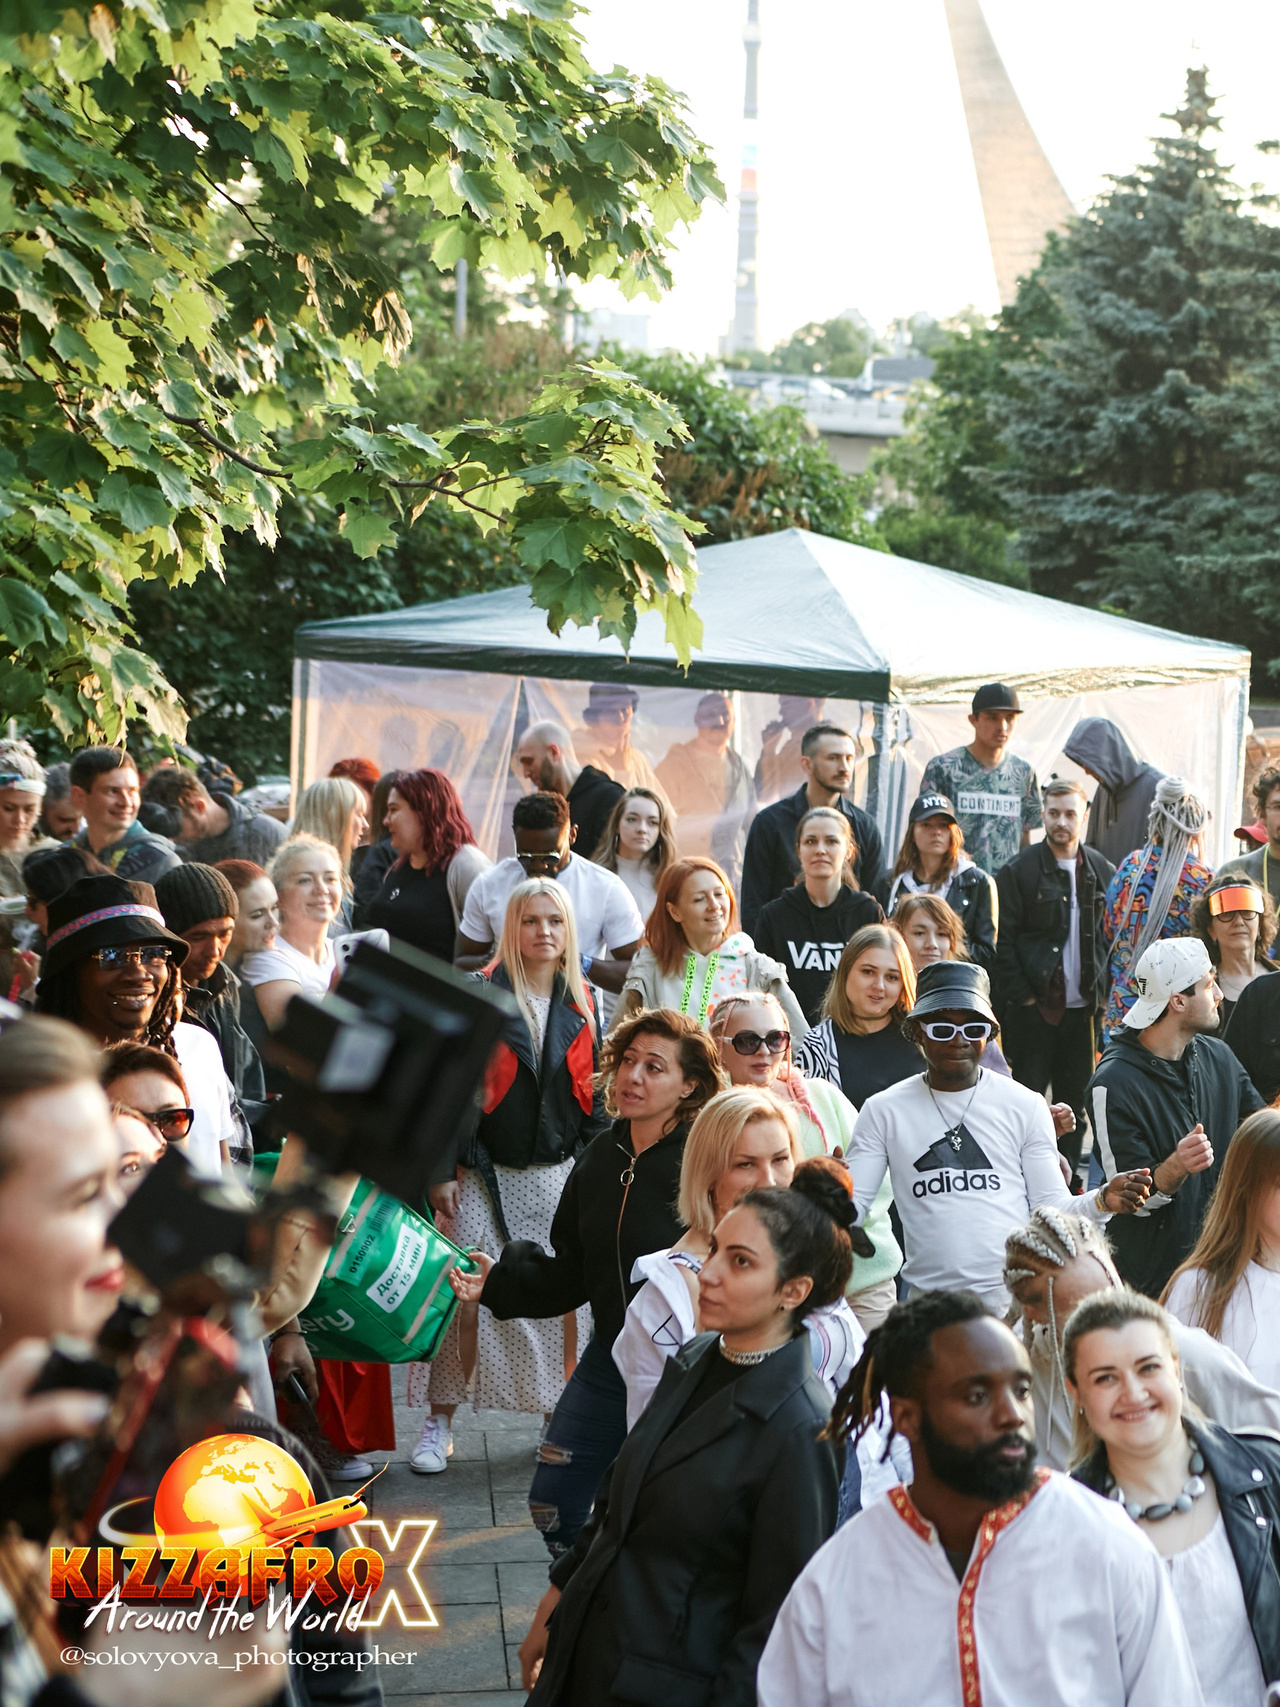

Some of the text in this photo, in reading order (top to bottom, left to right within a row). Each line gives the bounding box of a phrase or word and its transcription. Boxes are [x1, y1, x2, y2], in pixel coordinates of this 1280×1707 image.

[922, 796, 949, 809] NYC
[960, 797, 1020, 812] CONTINENT
[786, 940, 843, 971] VAN
[912, 1170, 1001, 1198] adidas
[348, 1234, 376, 1274] 0150902
[376, 1235, 411, 1297] Доставка
[386, 1289, 400, 1305] от
[400, 1271, 412, 1287] 15
[300, 1308, 355, 1332] ery
